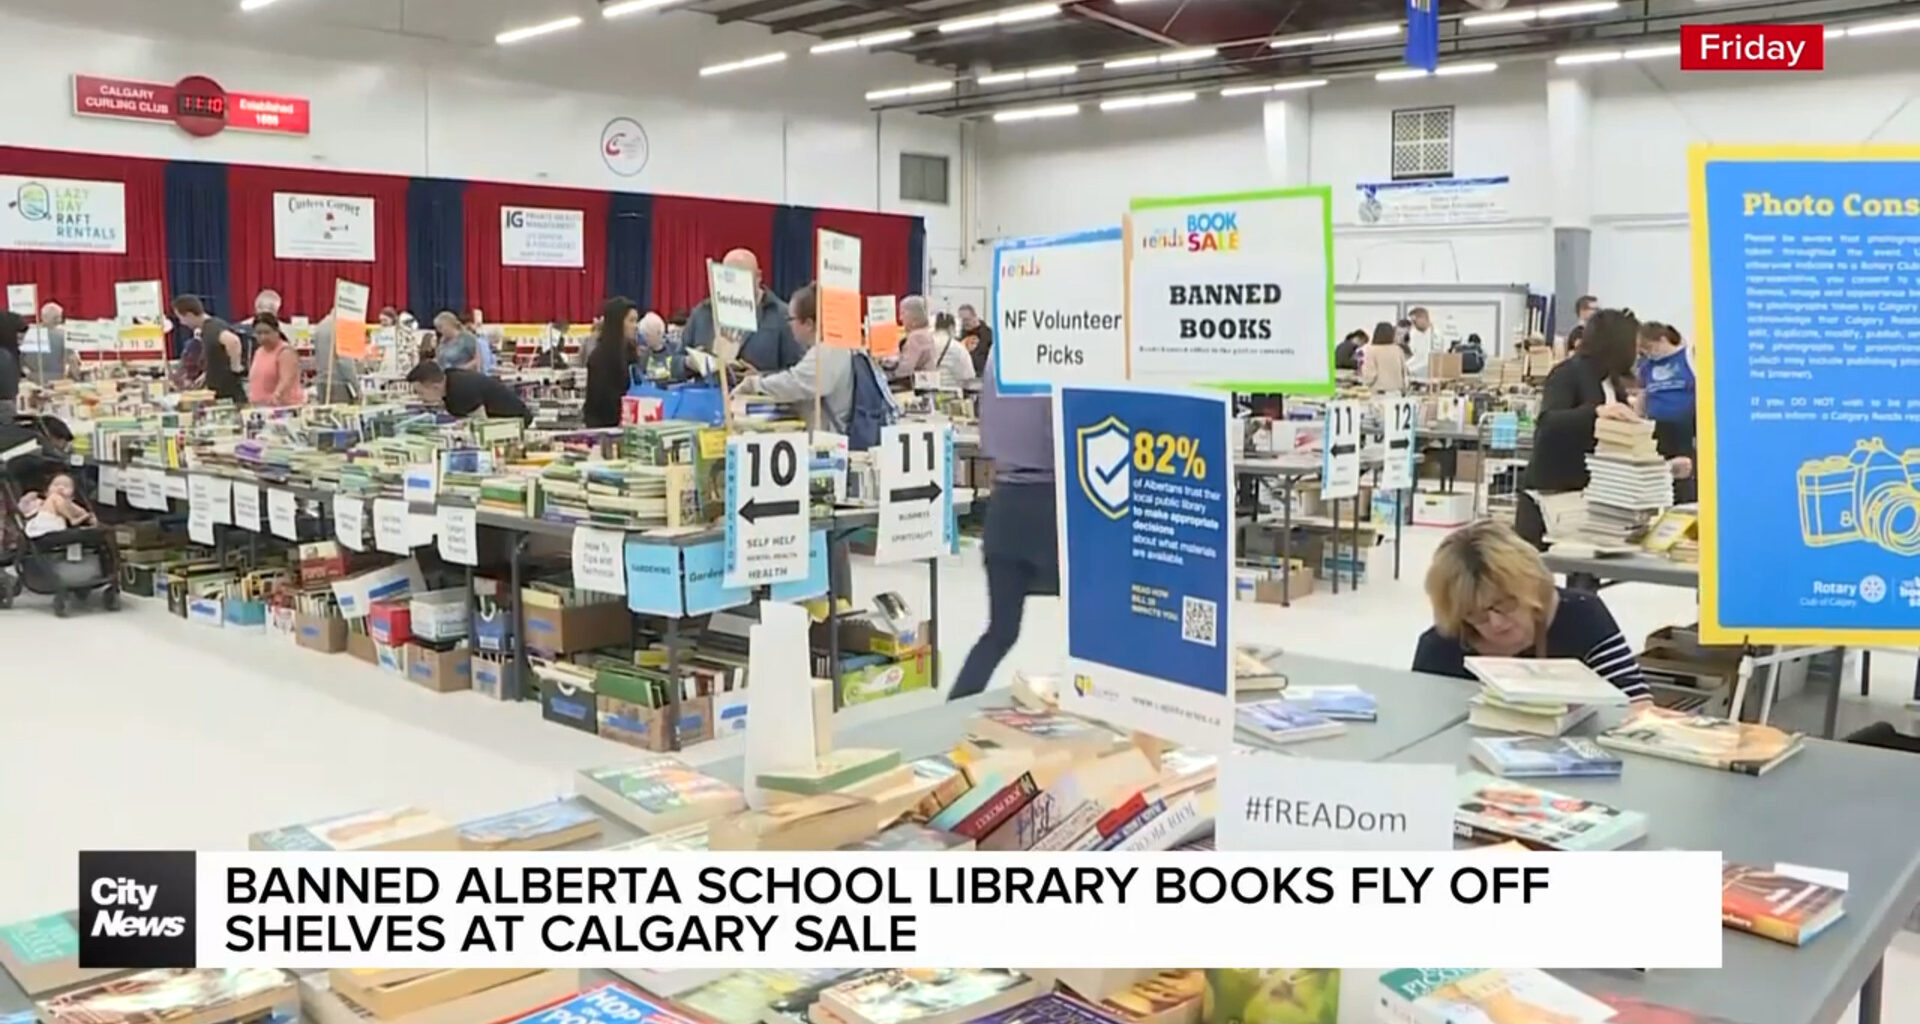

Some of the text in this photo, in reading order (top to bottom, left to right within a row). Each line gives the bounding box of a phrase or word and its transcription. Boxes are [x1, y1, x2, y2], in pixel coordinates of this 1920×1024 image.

[100, 84, 154, 100] CALGARY
[86, 96, 169, 115] CURLING CLUB
[240, 98, 293, 115] Established
[55, 187, 89, 200] LAZY
[1743, 191, 1835, 217] Photo
[56, 200, 83, 212] DAY
[56, 213, 90, 225] RAFT
[506, 210, 524, 229] IG
[1187, 212, 1238, 233] BOOK
[57, 226, 116, 240] RENTALS
[1187, 232, 1239, 252] SALE
[1169, 284, 1282, 306] BANNED
[1004, 309, 1122, 331] NF Volunteer
[1180, 318, 1272, 340] BOOKS
[1037, 344, 1084, 366] Picks
[1334, 406, 1352, 435] 11
[1395, 403, 1411, 431] 12
[746, 440, 797, 487] 10
[898, 432, 935, 474] 11
[1133, 431, 1207, 480] 82%
[1133, 478, 1143, 488] of
[1144, 479, 1183, 494] Albertans
[1185, 485, 1203, 498] trust
[1133, 491, 1206, 515] local public library
[1132, 520, 1175, 536] decisions
[1133, 505, 1219, 530] to make appropriate
[746, 535, 796, 549] SELF HELP
[1133, 534, 1217, 559] about what materials
[1132, 548, 1145, 558] are
[631, 563, 671, 576] GARDENING
[748, 567, 787, 580] HEALTH
[1813, 580, 1857, 597] Rotary
[1166, 801, 1197, 829] JODI
[1245, 795, 1407, 832] #fREADom
[586, 990, 642, 1020] HOP
